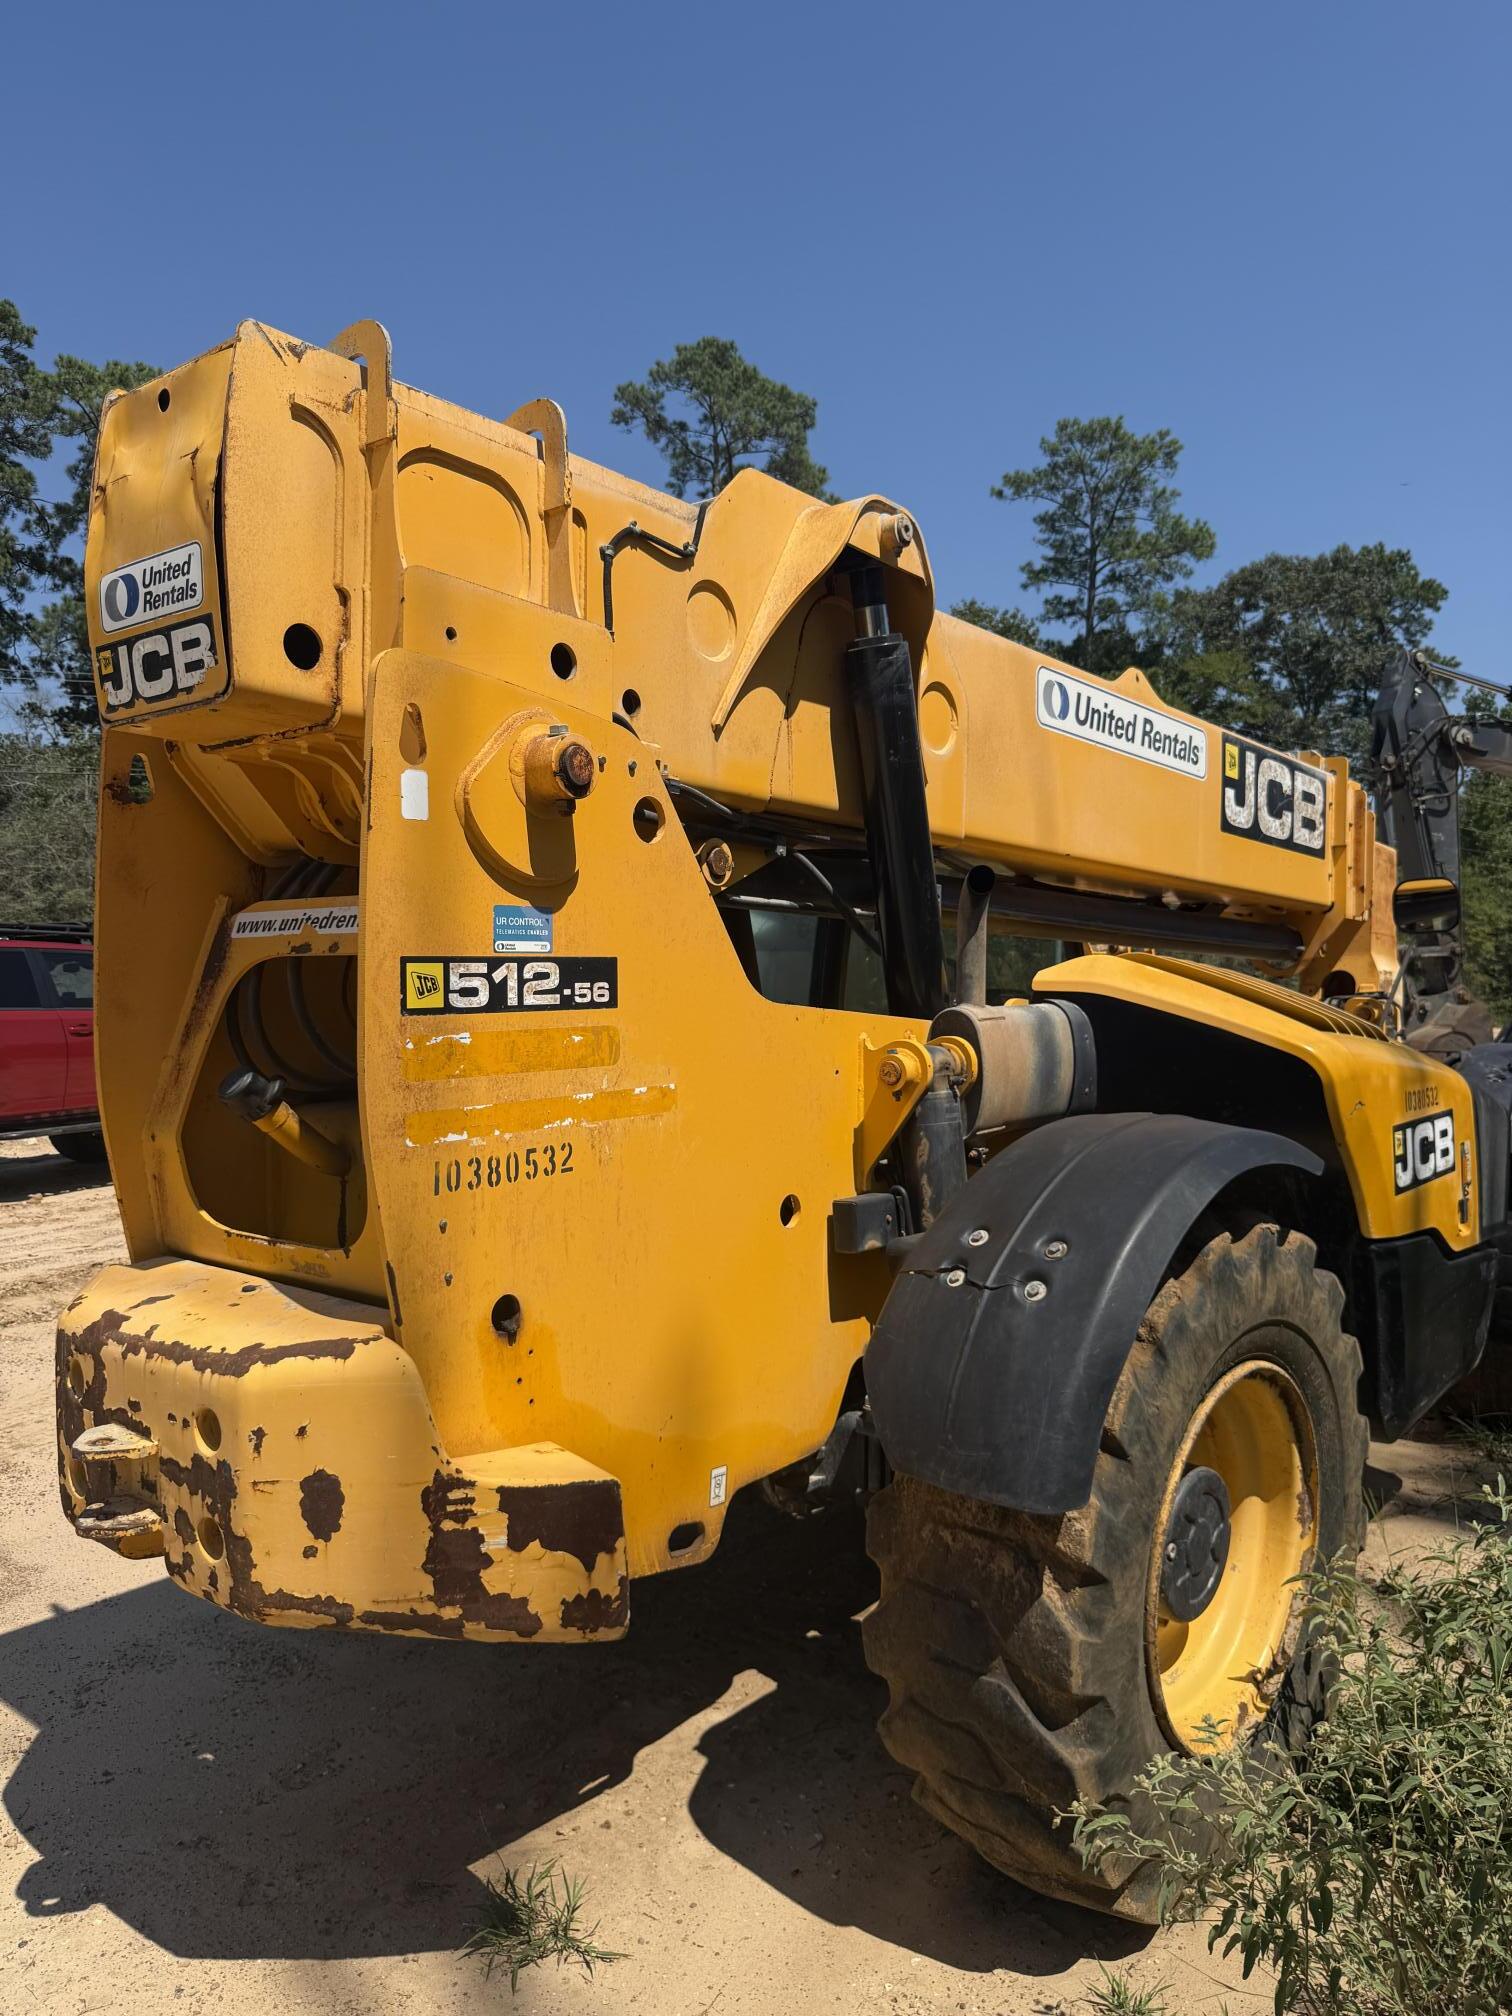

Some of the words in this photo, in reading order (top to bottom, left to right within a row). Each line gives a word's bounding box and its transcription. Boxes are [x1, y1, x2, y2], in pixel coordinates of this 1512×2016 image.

[142, 554, 192, 589] United
[143, 579, 198, 613] Rentals
[103, 622, 217, 706] JCB
[1075, 691, 1137, 744] United
[1140, 717, 1200, 767] Rentals
[1224, 750, 1324, 850] JCB
[236, 910, 359, 935] www.unitedren
[495, 916, 508, 926] UR
[508, 917, 544, 927] CONTROL
[415, 972, 439, 997] JCB
[448, 961, 611, 1009] 512-56
[1405, 1087, 1439, 1112] 10380532
[433, 1141, 574, 1197] 10380532
[1396, 1116, 1454, 1188] JCB
